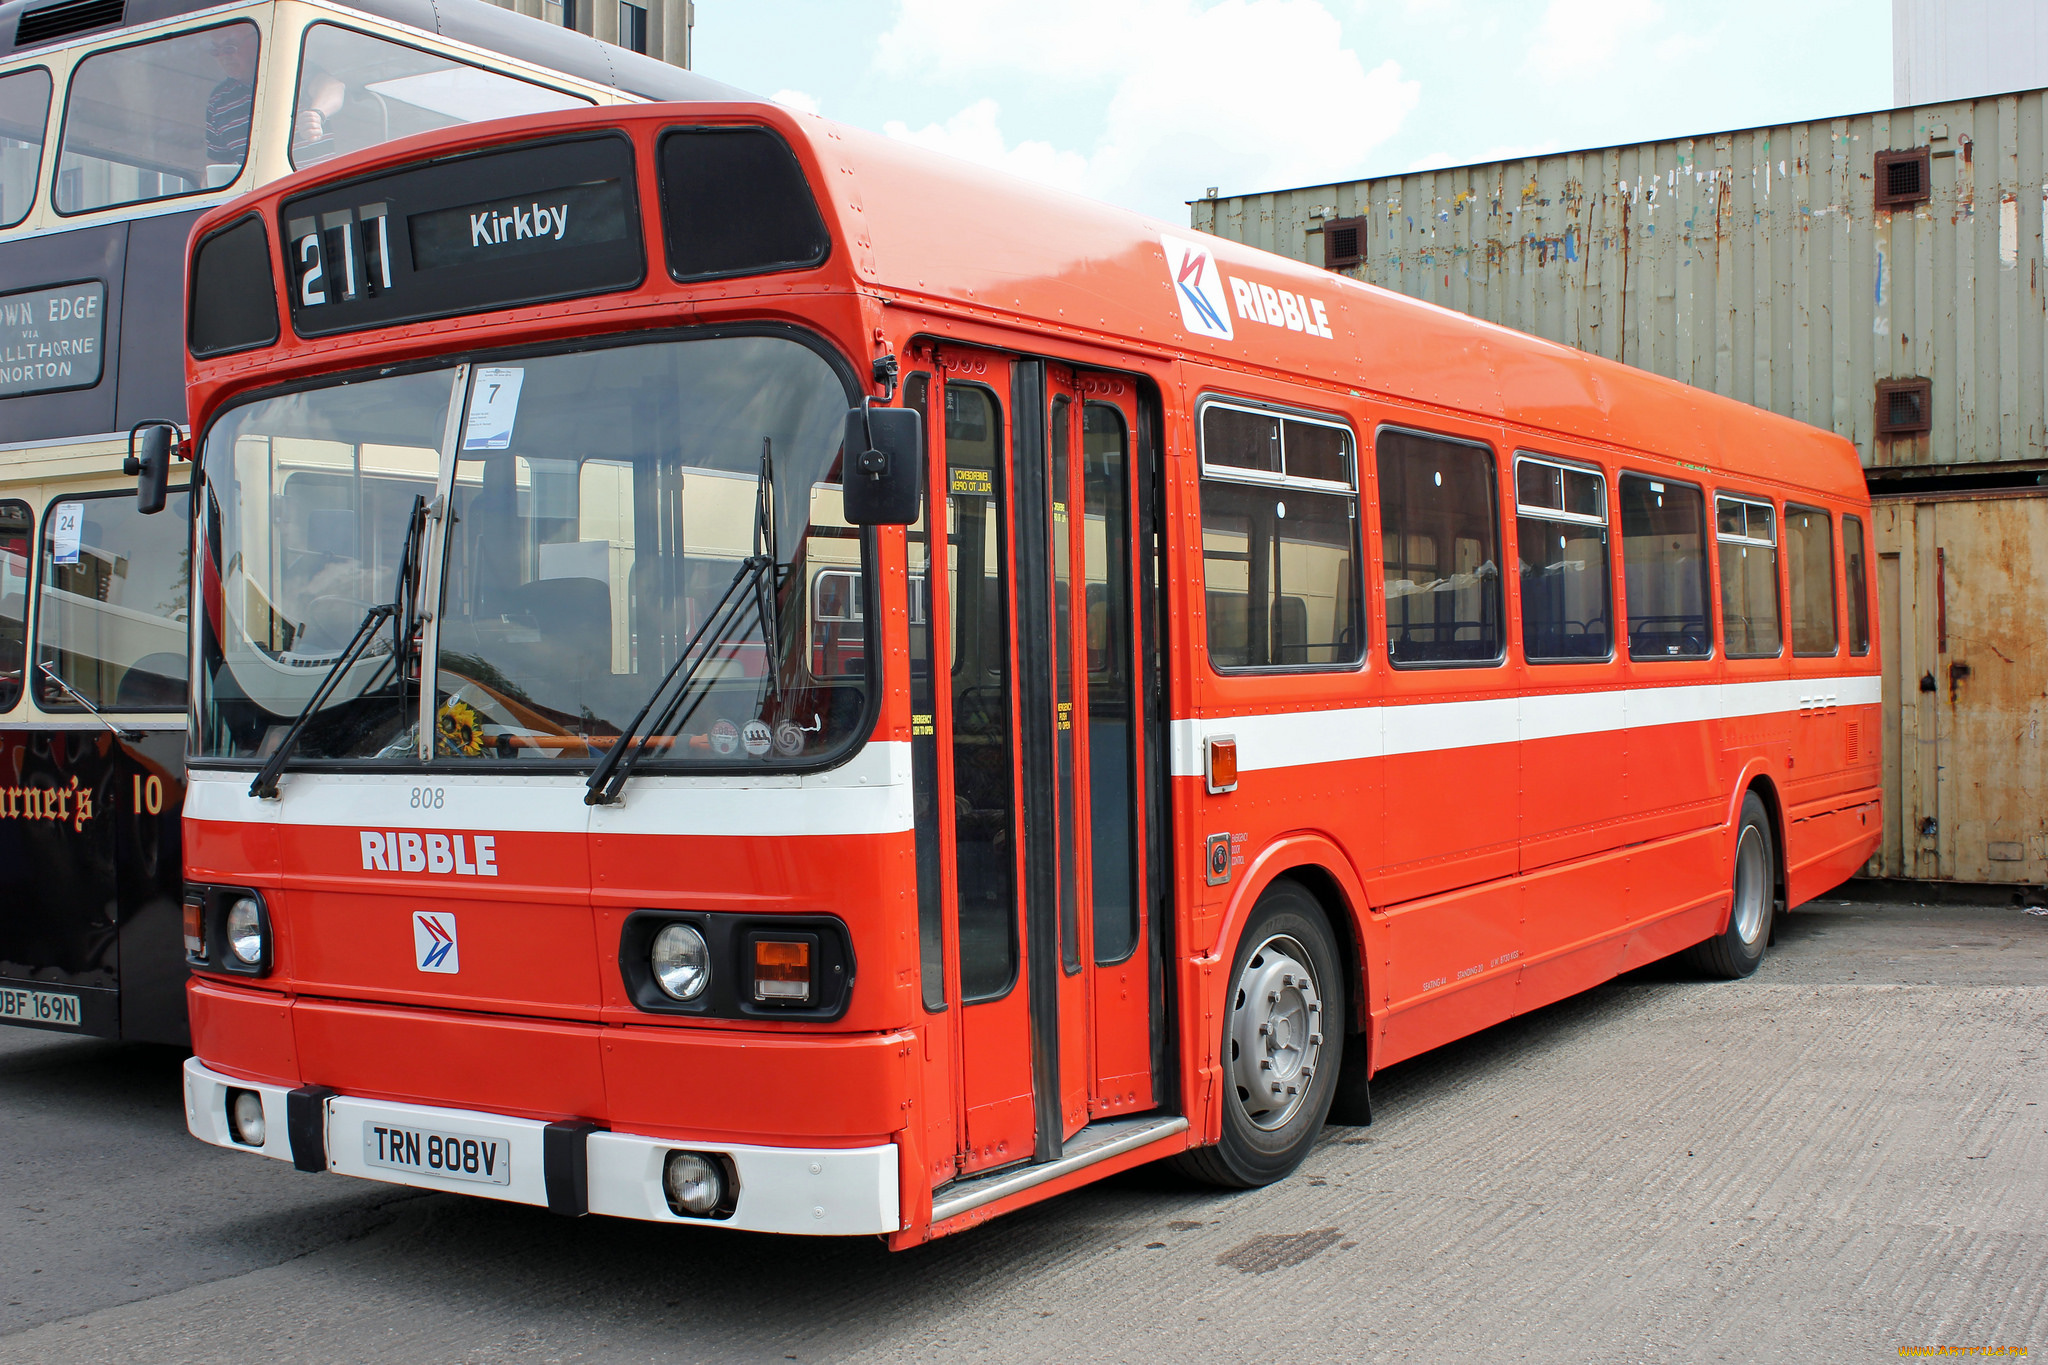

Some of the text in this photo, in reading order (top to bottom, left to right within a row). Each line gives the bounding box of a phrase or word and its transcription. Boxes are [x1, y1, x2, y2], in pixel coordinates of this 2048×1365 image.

[470, 203, 568, 247] Kirkby
[49, 296, 98, 322] EDGE
[1229, 276, 1334, 340] RIBBLE
[22, 330, 39, 338] VIA
[0, 361, 72, 383] NORTON
[488, 384, 501, 404] 7
[60, 515, 74, 531] 24
[133, 774, 162, 815] 10
[410, 787, 445, 809] 808
[360, 831, 498, 876] RIBBLE
[1457, 965, 1478, 980] STANDING
[1423, 978, 1440, 992] SEATING
[33, 994, 76, 1021] 169N
[374, 1127, 497, 1176] TRN 808V
